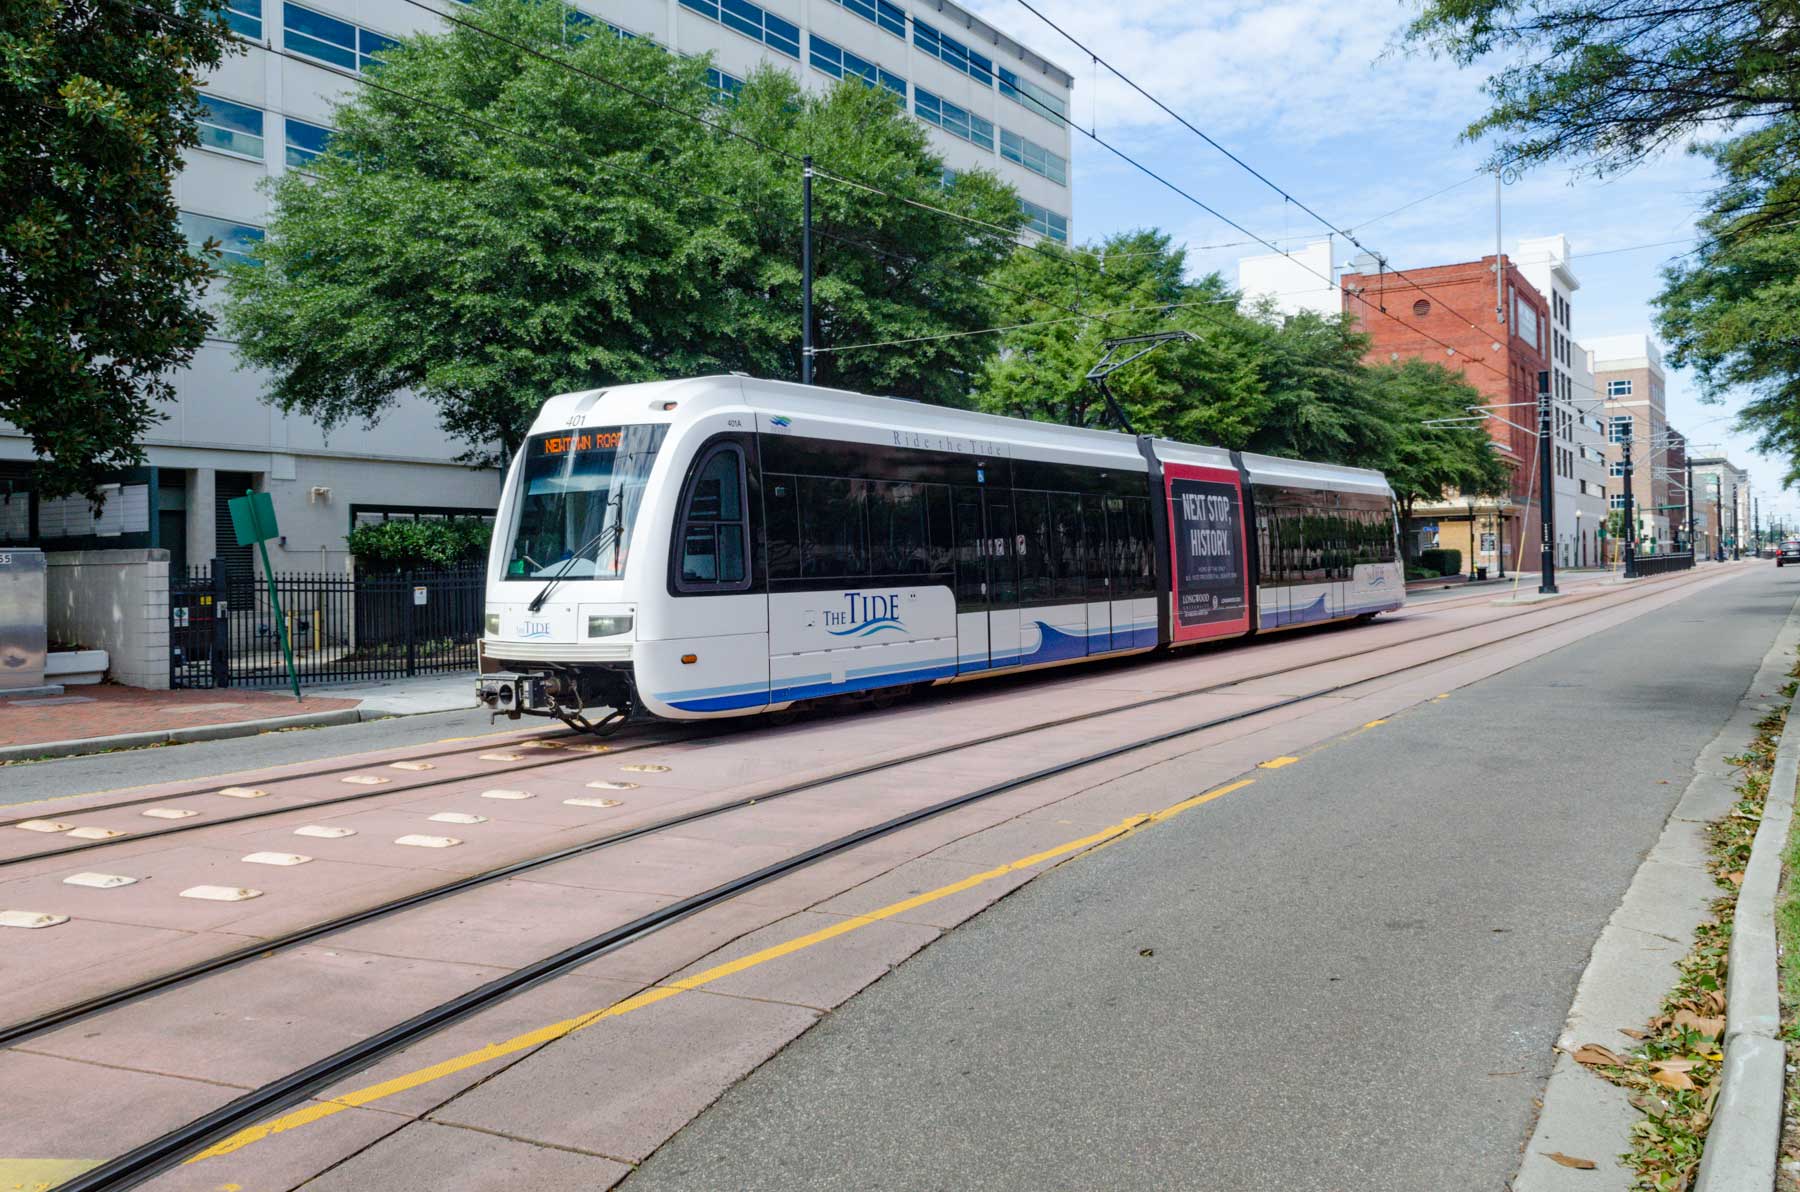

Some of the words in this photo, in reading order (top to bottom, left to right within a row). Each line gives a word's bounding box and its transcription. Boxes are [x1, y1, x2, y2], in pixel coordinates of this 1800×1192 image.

[565, 415, 586, 427] 401
[545, 434, 592, 453] NEWTOWN
[596, 431, 625, 449] ROAD
[893, 430, 930, 449] Ride
[939, 436, 964, 452] the
[969, 439, 1001, 456] Tide
[1182, 493, 1206, 521] NEXT
[1207, 494, 1232, 526] STOP,
[1190, 529, 1231, 557] HISTORY.
[823, 610, 846, 626] THE
[844, 592, 900, 624] TIDE
